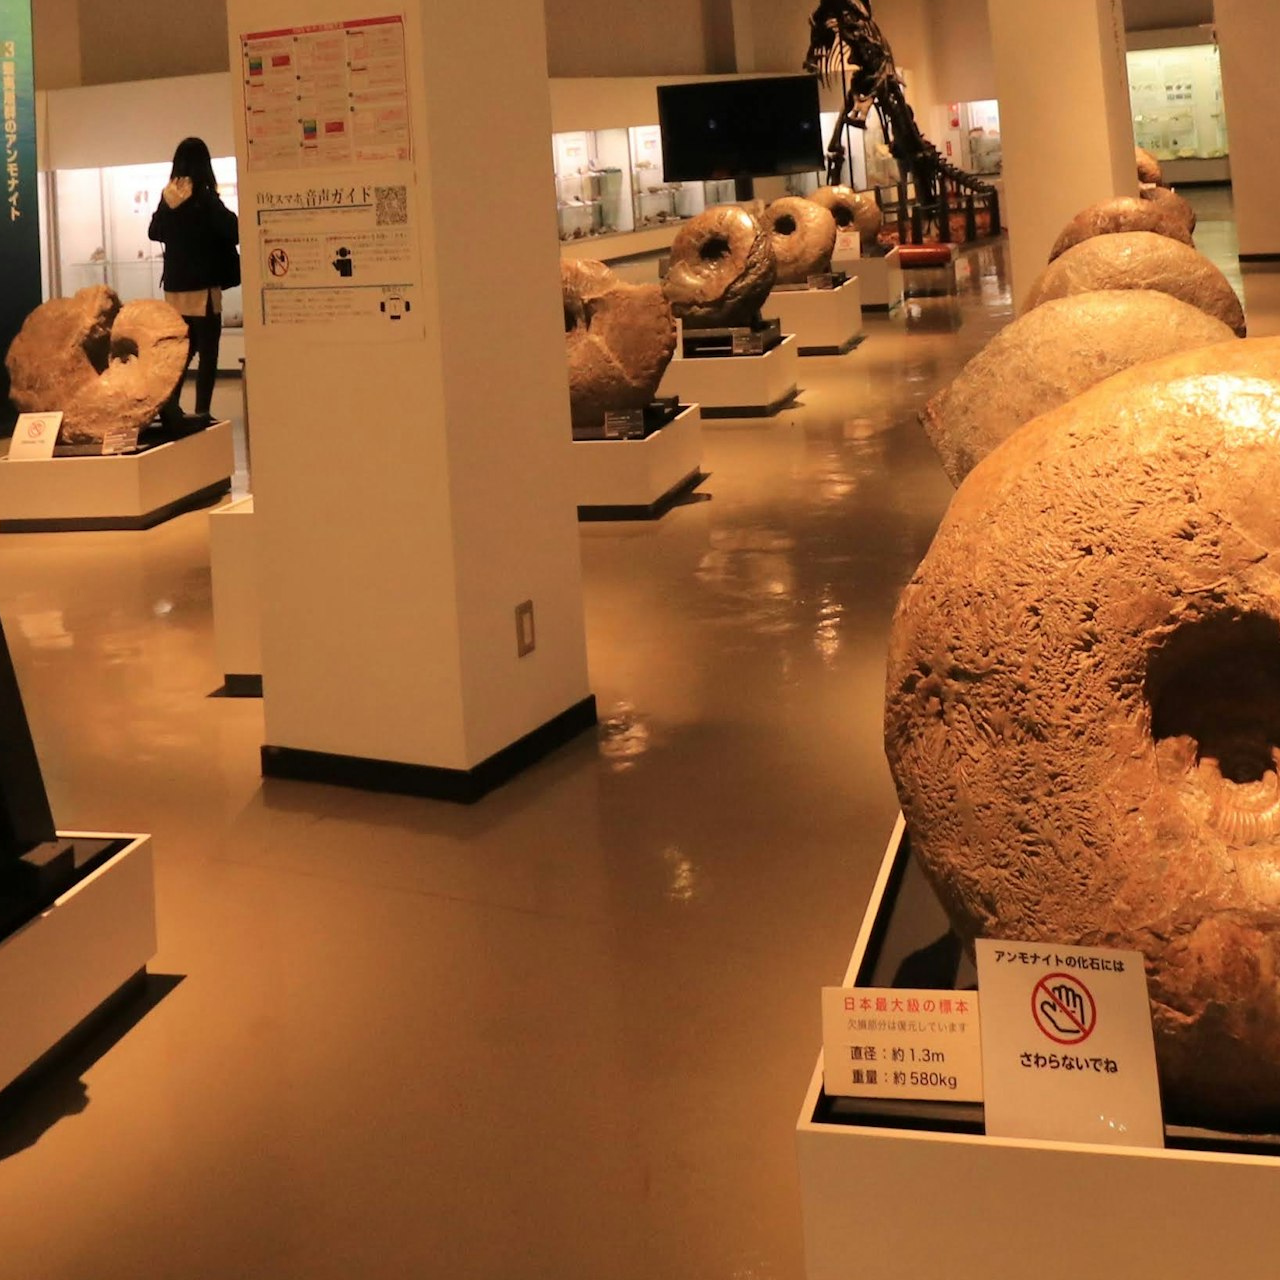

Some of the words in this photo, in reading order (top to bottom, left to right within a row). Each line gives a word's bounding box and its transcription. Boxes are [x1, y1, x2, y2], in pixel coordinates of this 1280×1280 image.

[4, 41, 15, 58] 3
[994, 950, 1126, 973] アンモナイトの化石には
[843, 996, 970, 1015] 日本最大級の標本
[1019, 1051, 1119, 1074] さわらないでね
